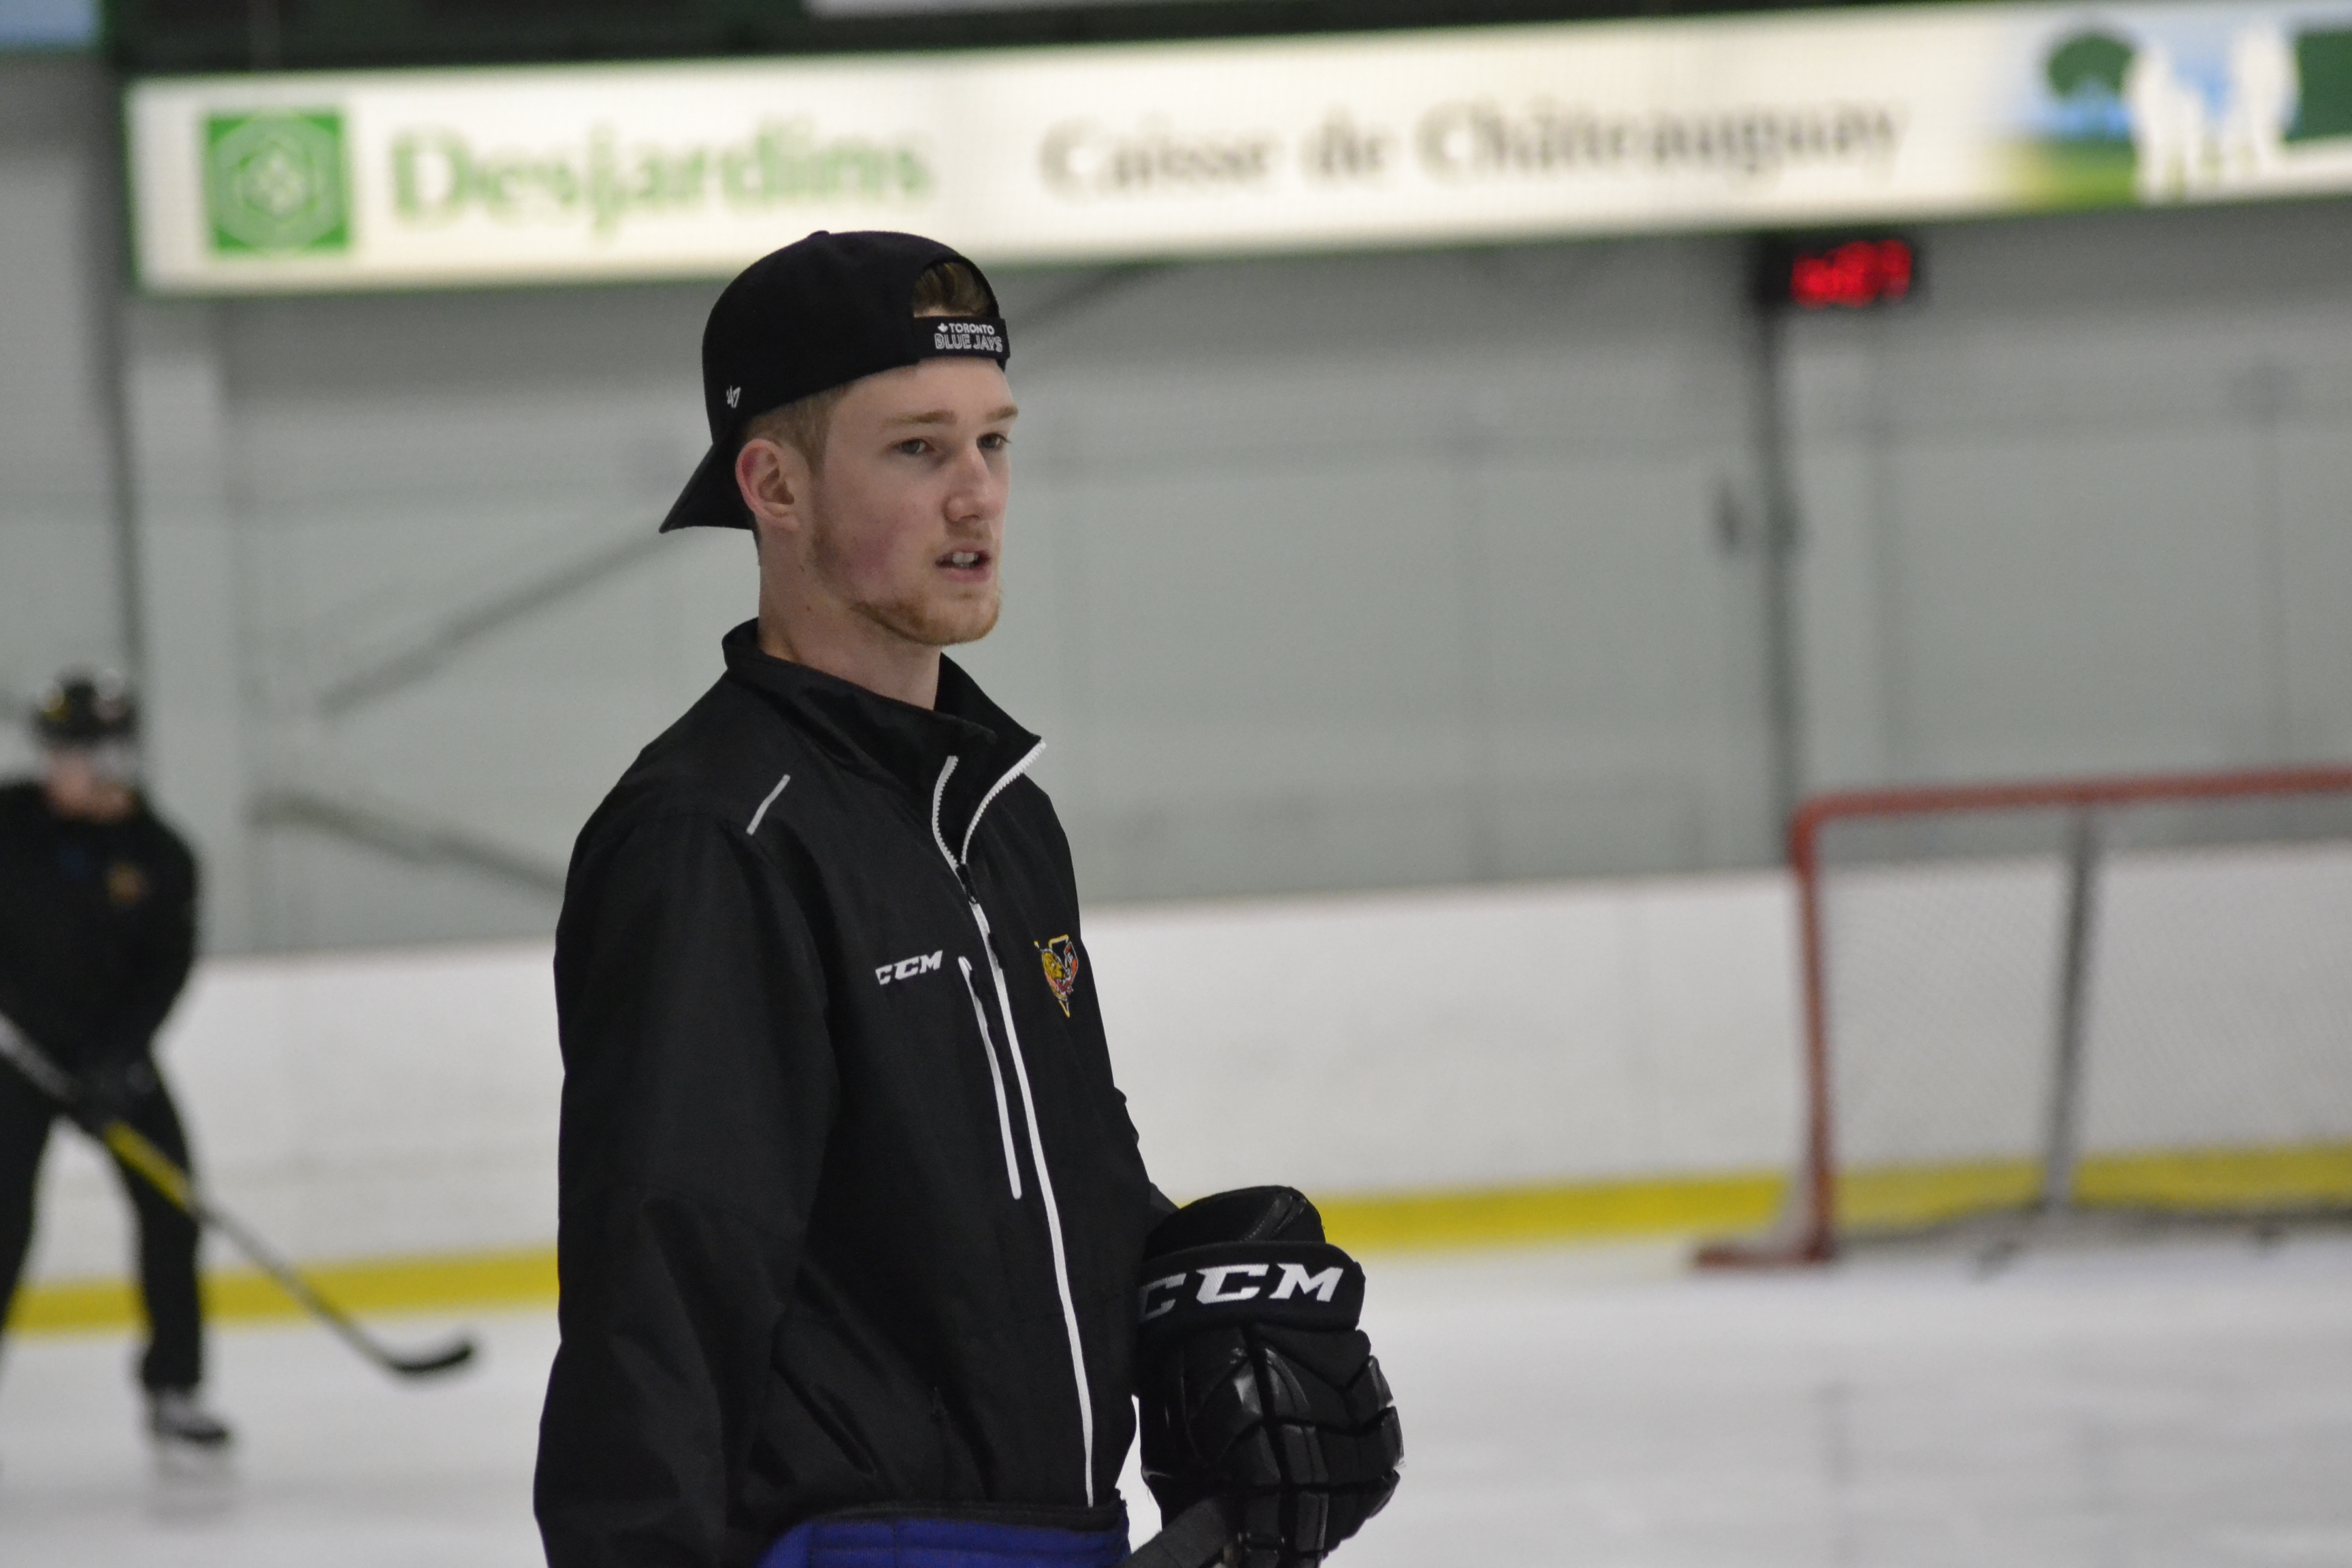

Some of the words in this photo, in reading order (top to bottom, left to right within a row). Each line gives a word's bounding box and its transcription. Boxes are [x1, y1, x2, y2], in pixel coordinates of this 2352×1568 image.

[1301, 105, 1392, 189] de
[389, 120, 932, 237] Desjardins
[934, 333, 972, 350] BLUE
[973, 334, 1003, 353] JAYS
[949, 323, 994, 335] TORONTO
[875, 950, 943, 985] CCM
[1139, 1263, 1343, 1322] CCM
